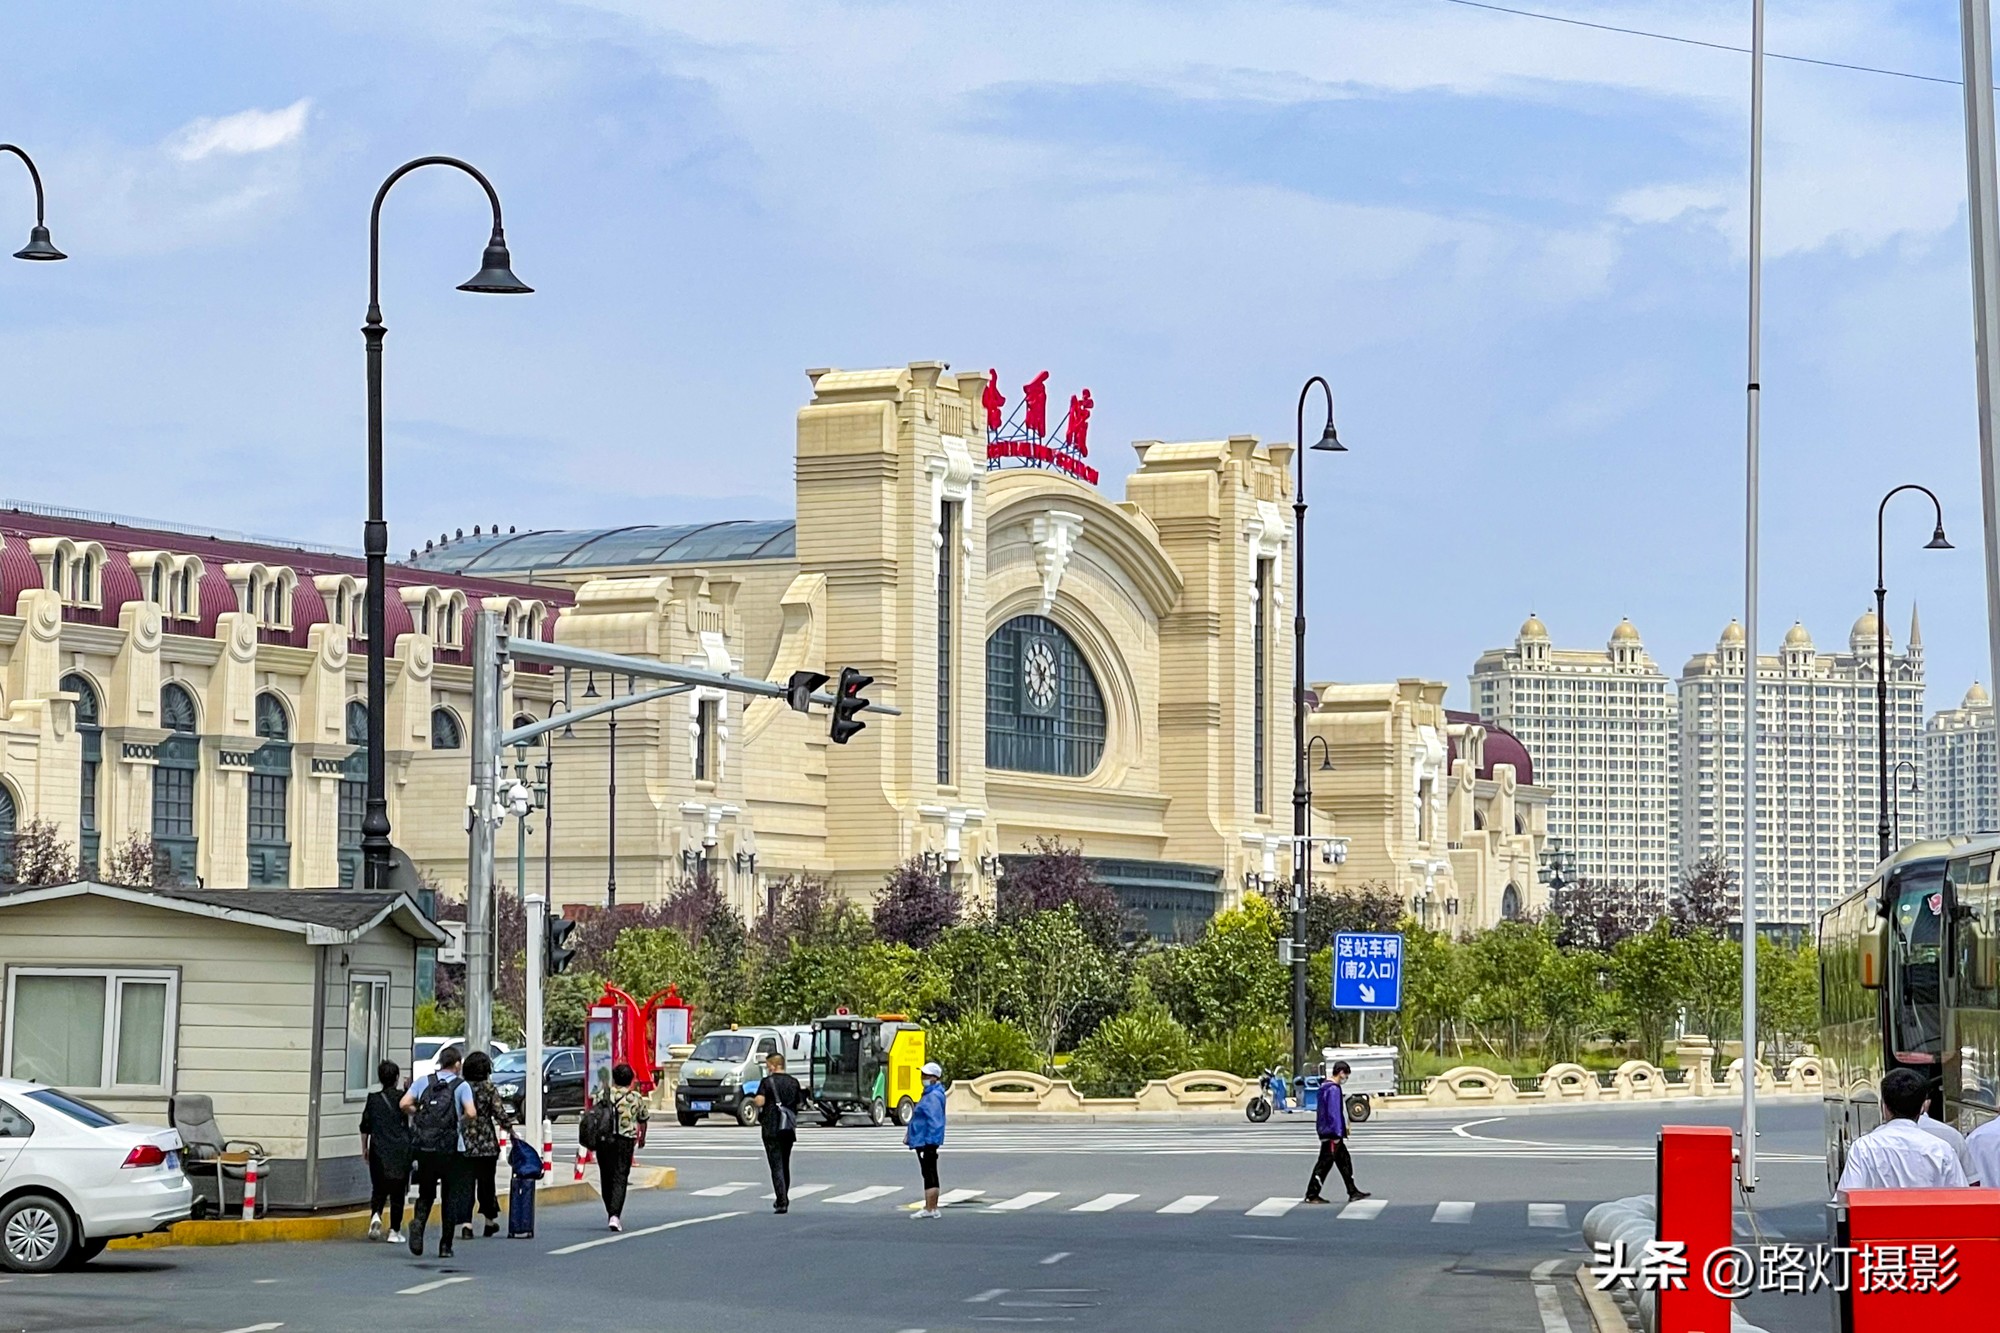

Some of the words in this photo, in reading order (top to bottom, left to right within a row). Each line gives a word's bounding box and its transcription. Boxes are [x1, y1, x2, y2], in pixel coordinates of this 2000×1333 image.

[1339, 937, 1398, 959] 送站车辆
[1340, 960, 1395, 980] (南2入口)
